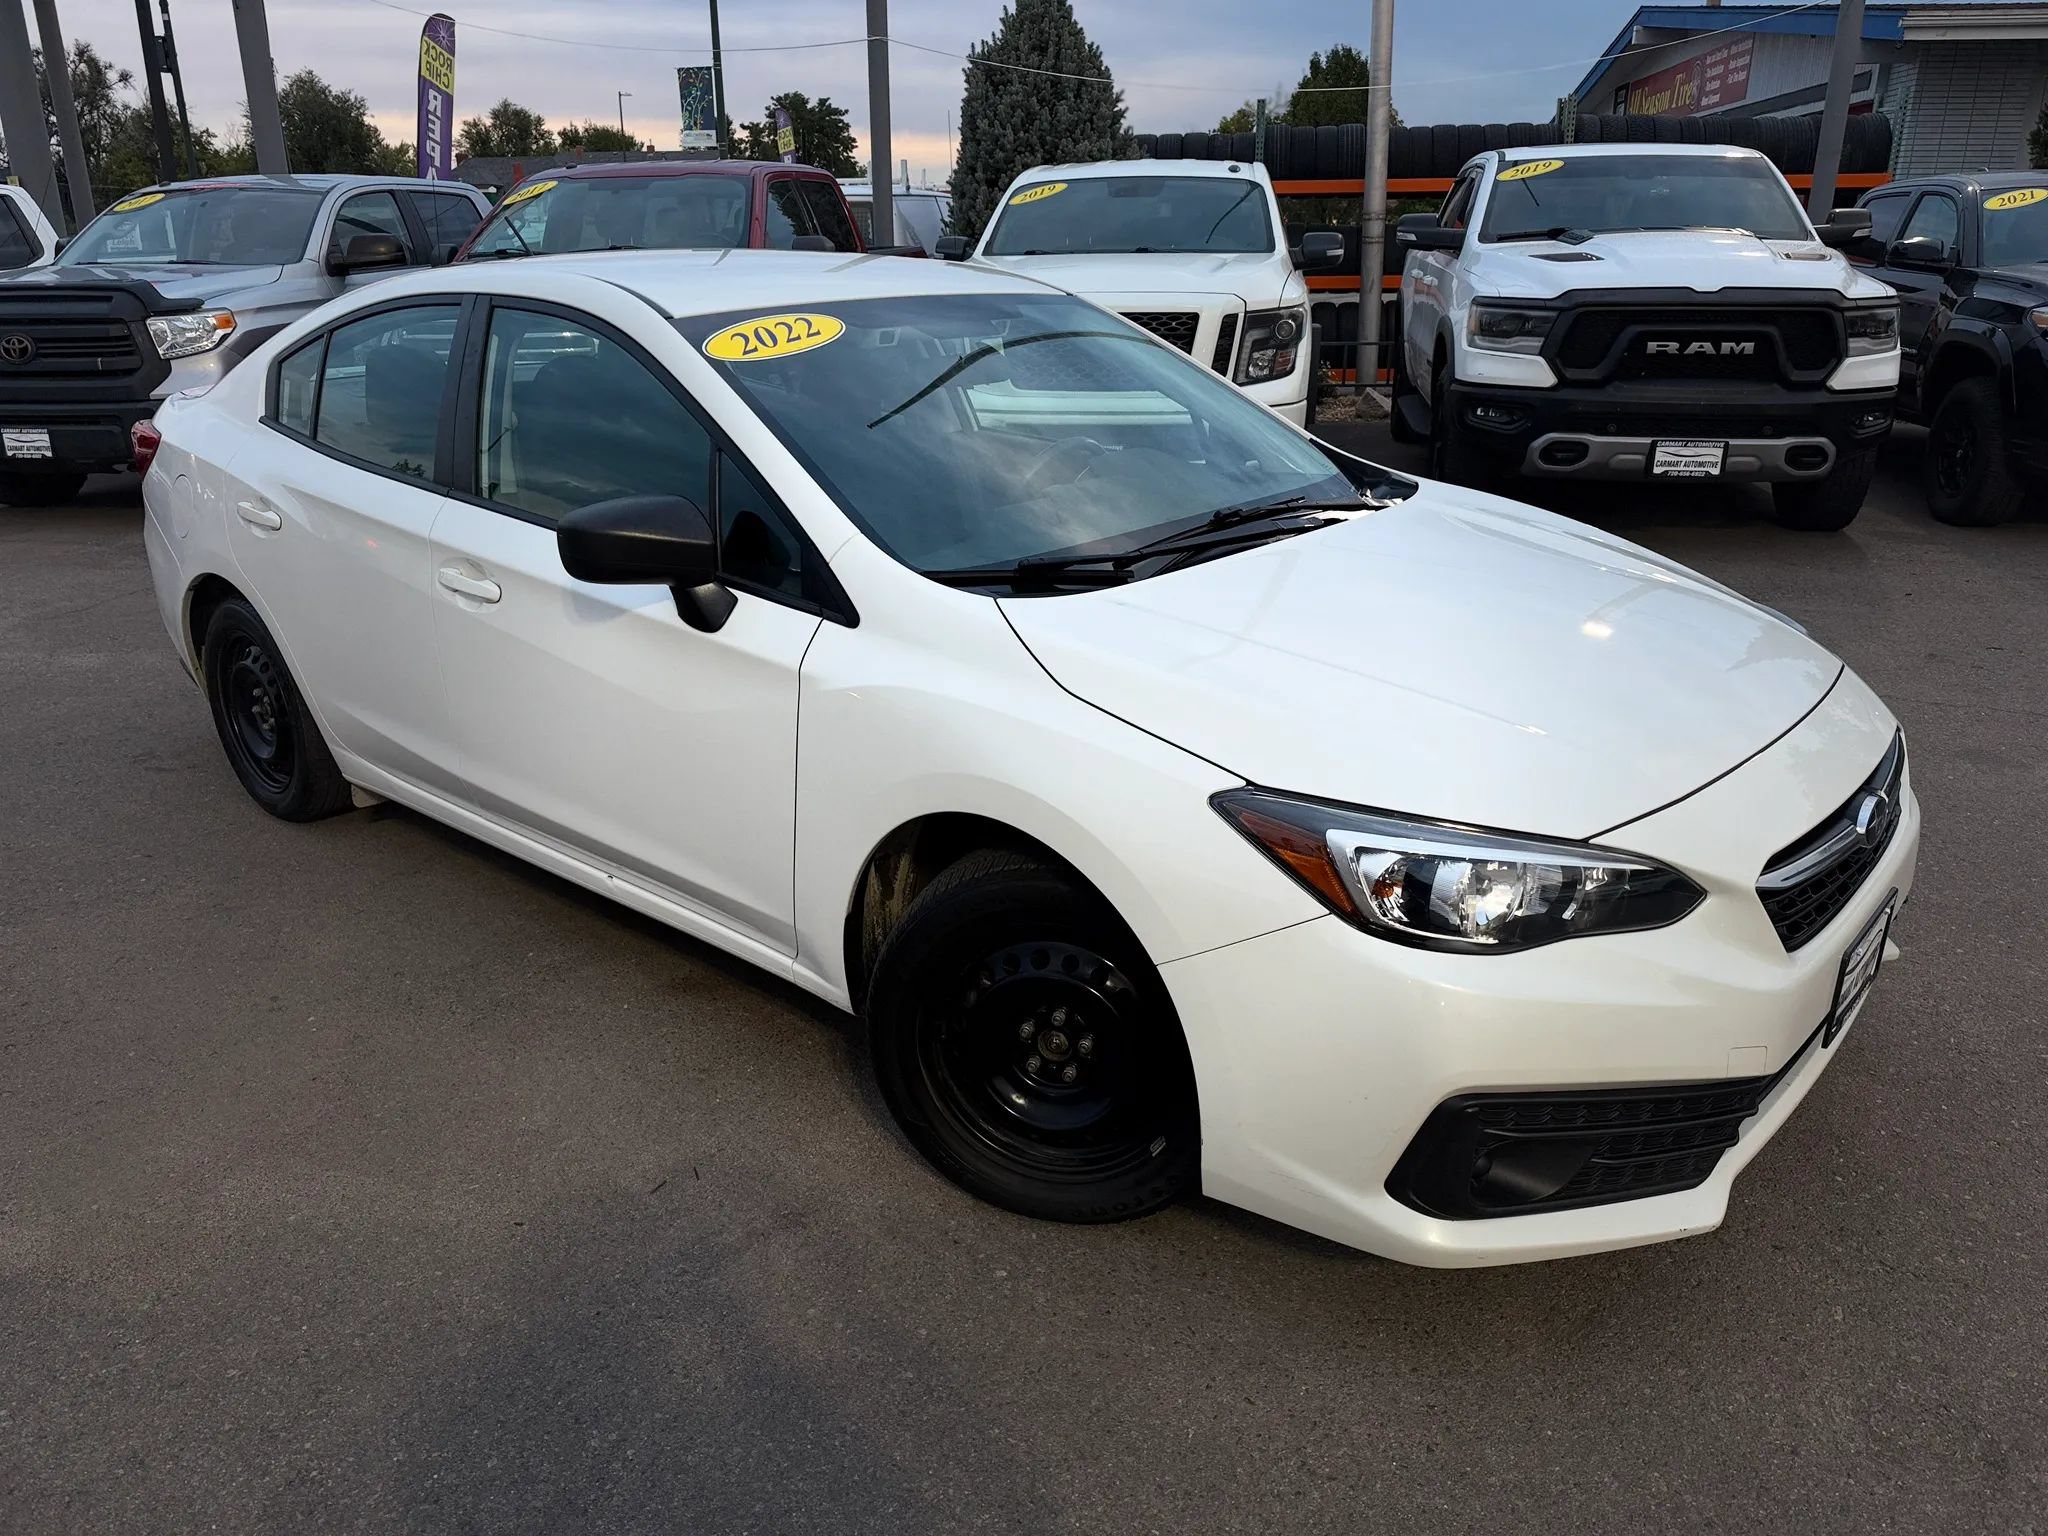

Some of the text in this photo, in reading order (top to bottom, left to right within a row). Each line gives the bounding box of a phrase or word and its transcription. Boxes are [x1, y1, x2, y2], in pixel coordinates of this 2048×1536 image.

[1642, 87, 1671, 115] Season
[1510, 161, 1552, 178] 2019
[1020, 185, 1056, 202] 2019
[1997, 190, 2035, 207] 2021
[730, 317, 822, 356] 2022
[1646, 341, 1755, 355] RAM
[1656, 460, 1719, 469] CARMART AUTOMOTIVE
